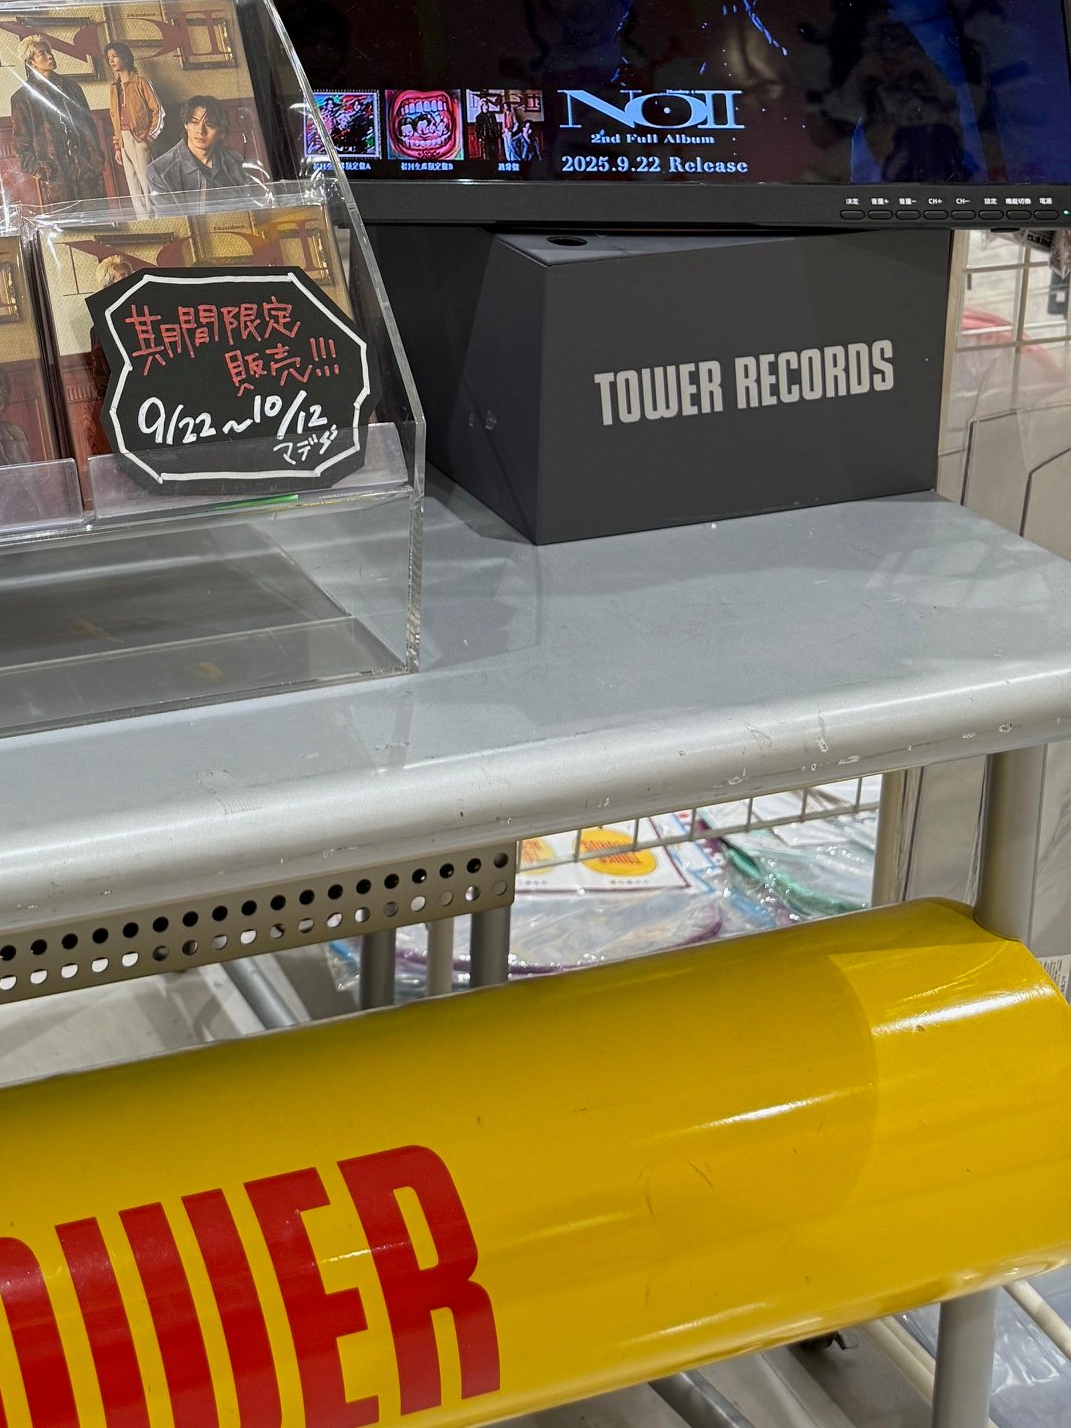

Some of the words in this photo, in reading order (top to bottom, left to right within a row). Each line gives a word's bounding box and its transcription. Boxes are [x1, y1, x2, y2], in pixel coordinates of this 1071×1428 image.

[561, 156, 662, 172] 2025.9.22
[668, 156, 749, 173] Release
[590, 133, 621, 144] 2nd
[626, 133, 659, 144] Full
[663, 133, 715, 144] Album
[125, 295, 302, 376] 期間限定
[224, 336, 340, 396] 販売!!!
[593, 358, 722, 427] TOWER
[734, 338, 895, 411] RECORDS
